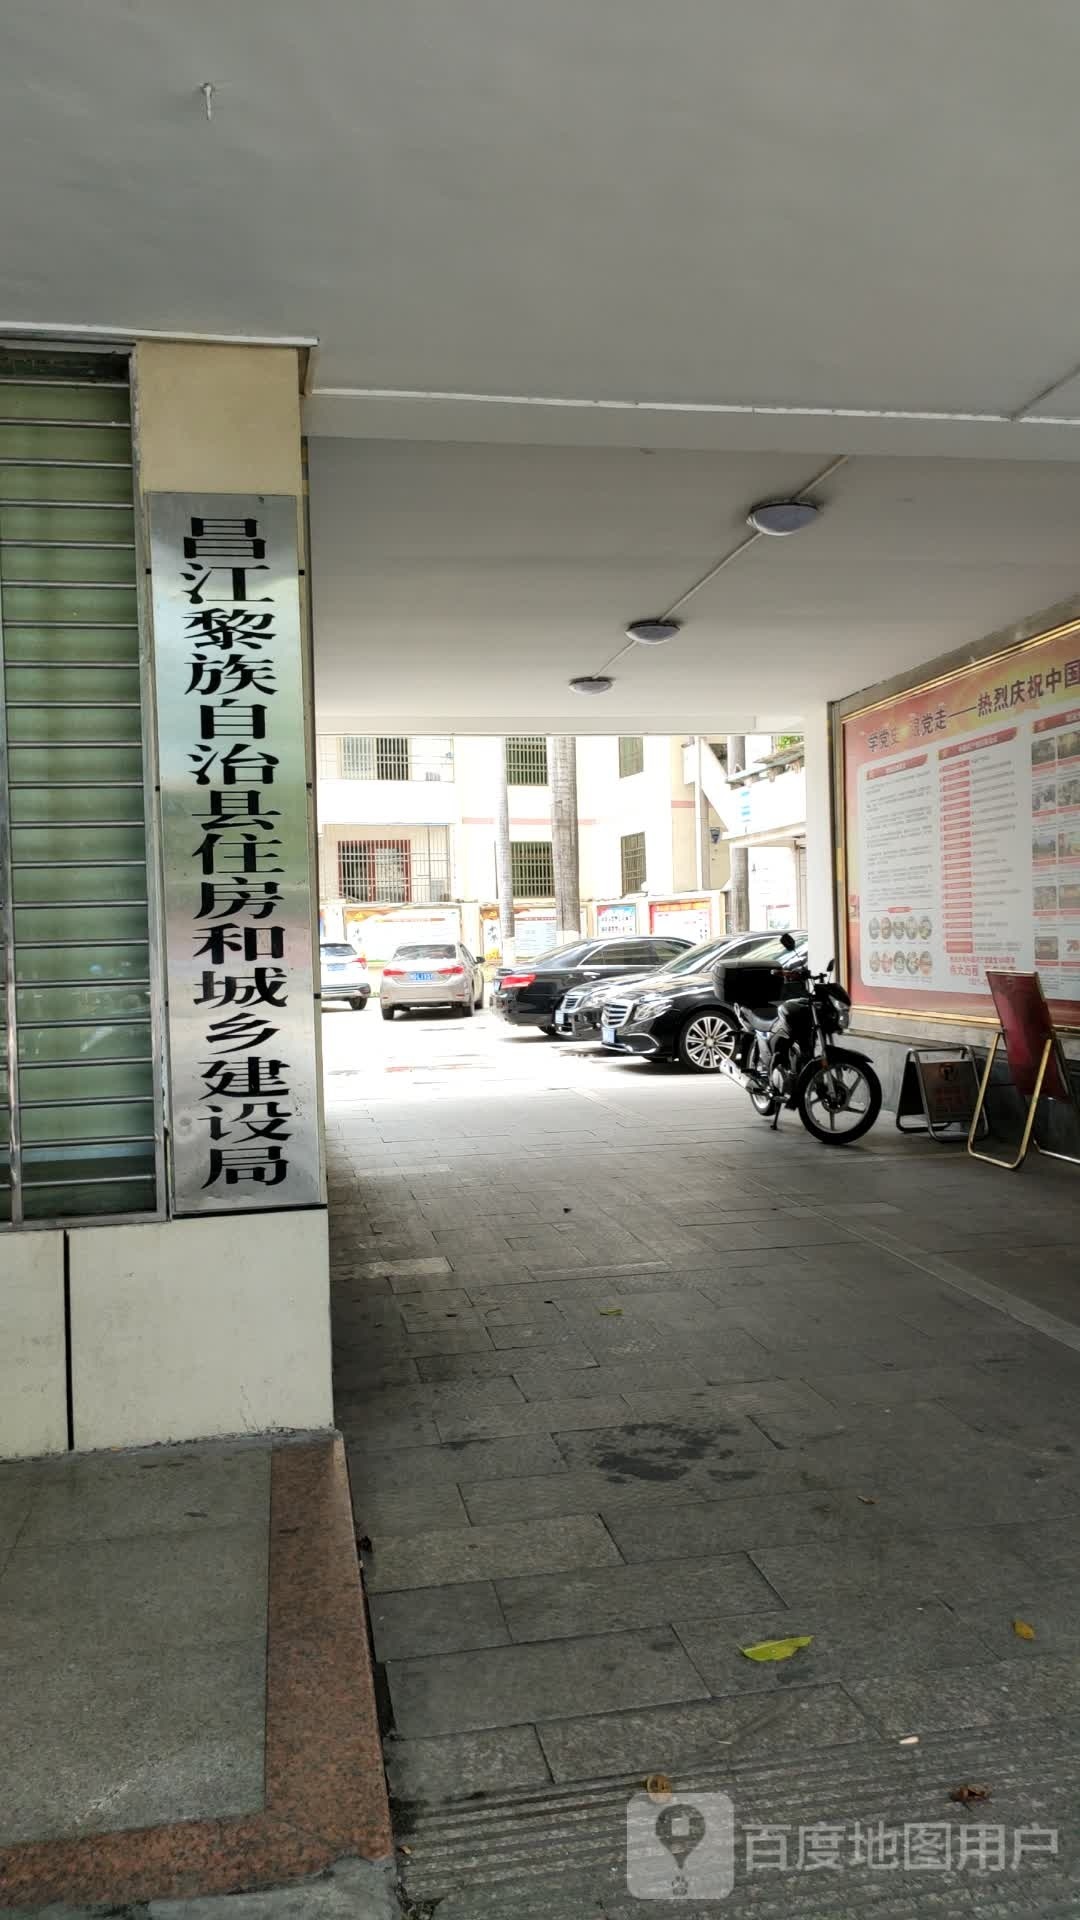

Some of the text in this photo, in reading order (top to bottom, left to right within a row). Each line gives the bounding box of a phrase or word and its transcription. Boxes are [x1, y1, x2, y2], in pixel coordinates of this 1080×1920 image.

[180, 517, 292, 1189] 昌江黎族自治县住房和城乡建设局
